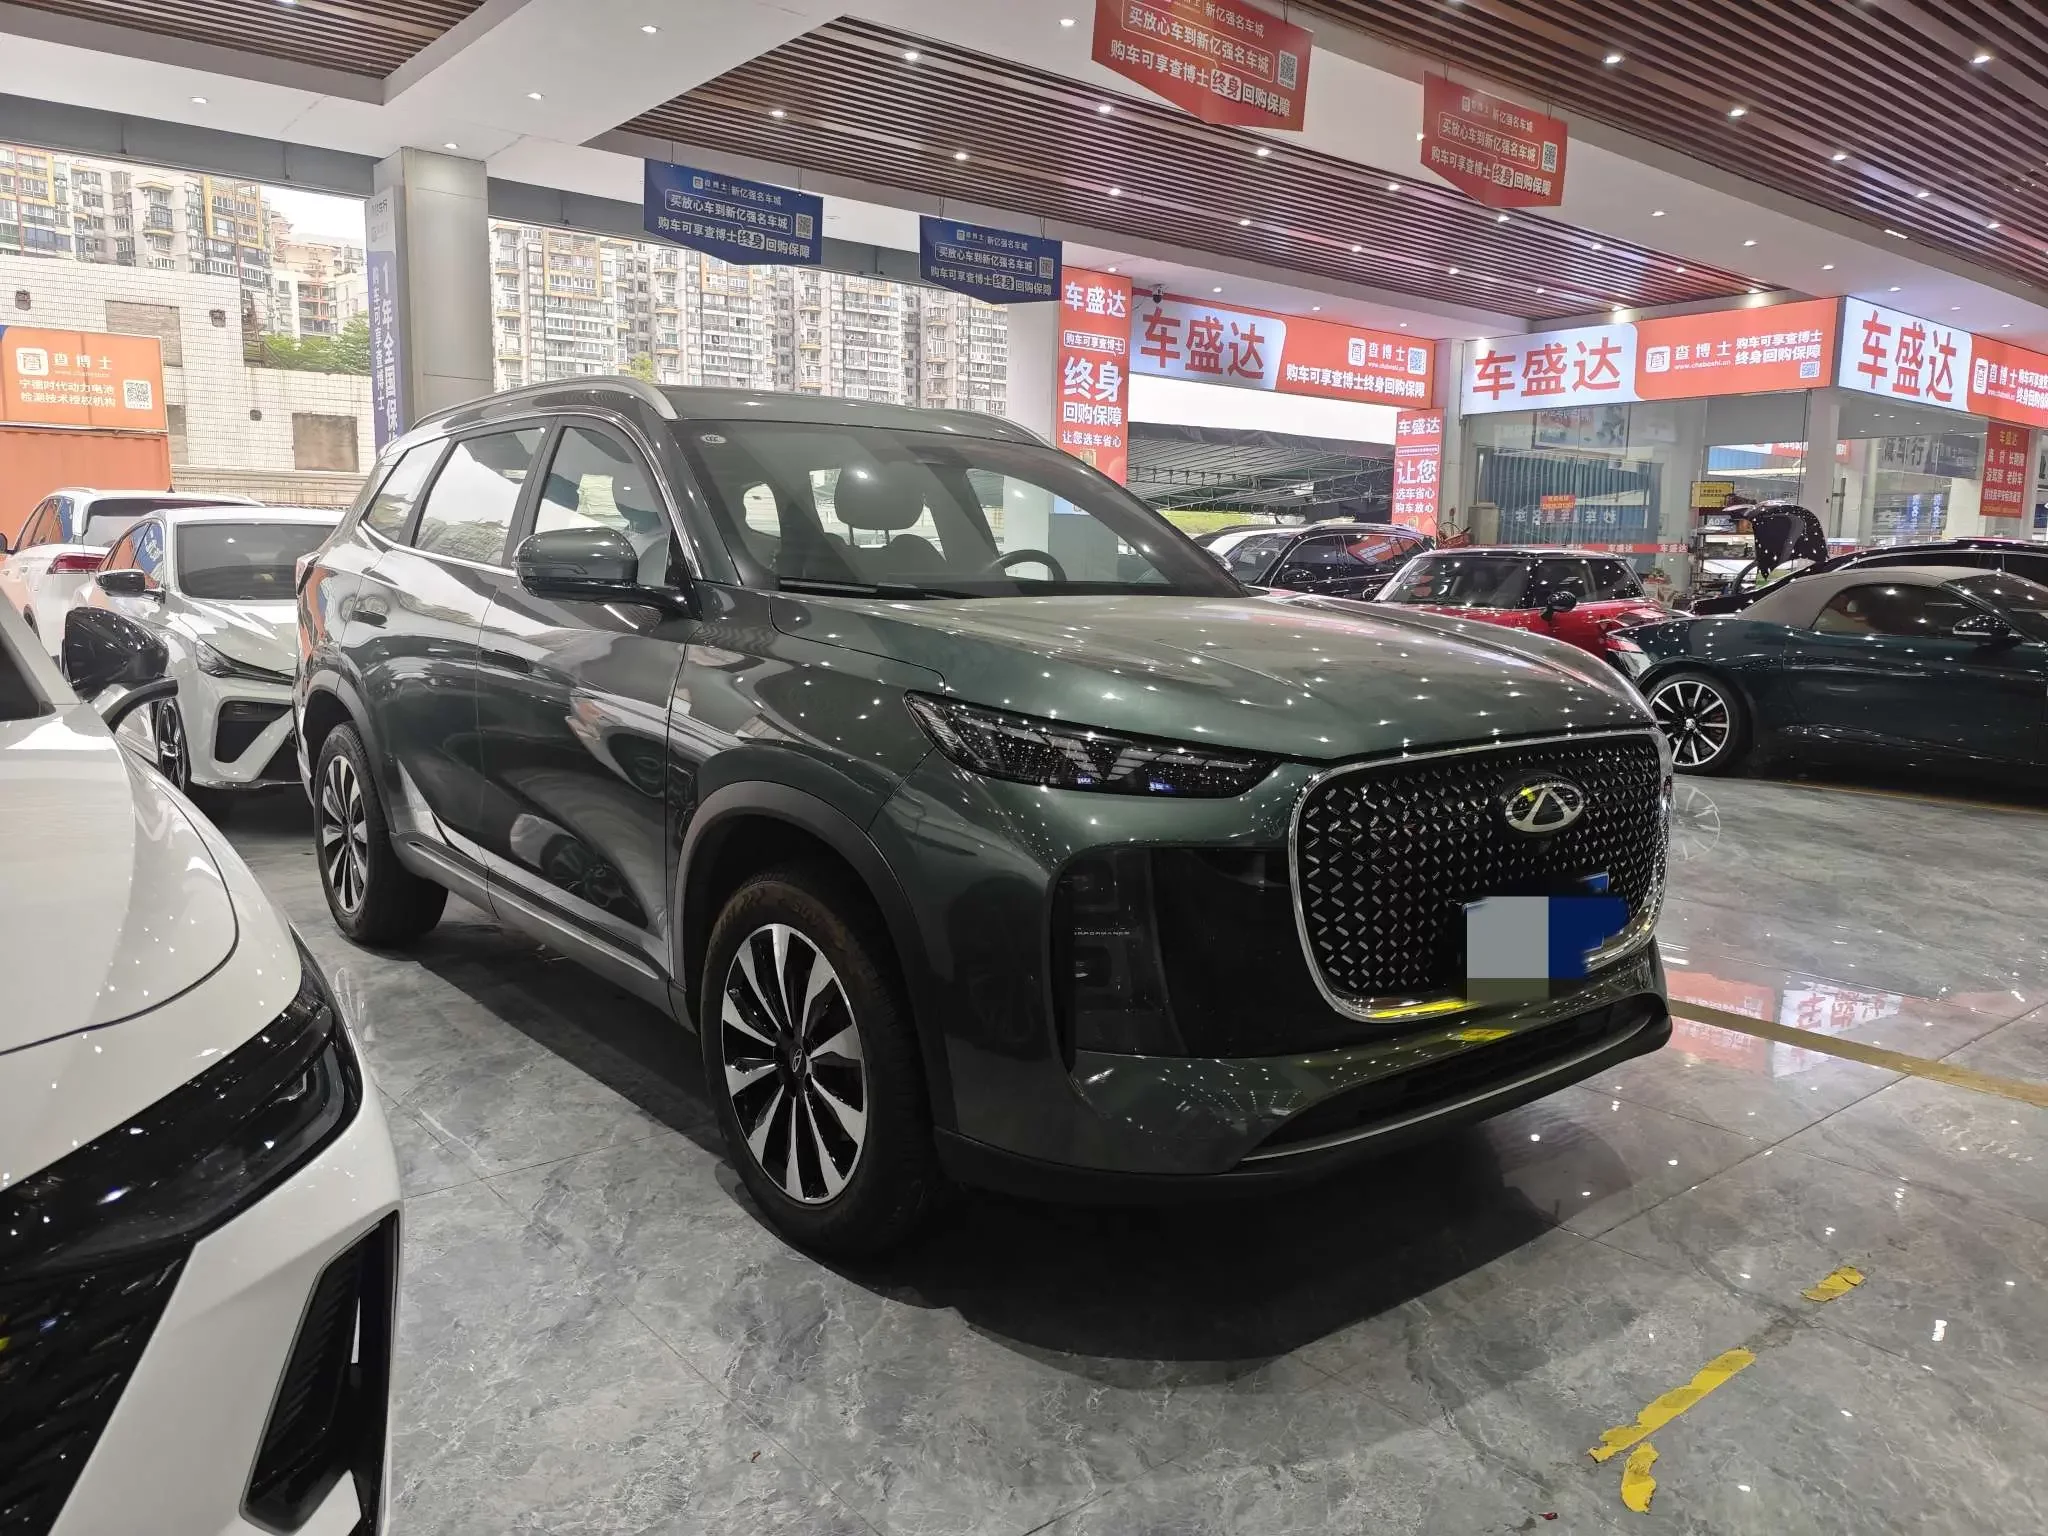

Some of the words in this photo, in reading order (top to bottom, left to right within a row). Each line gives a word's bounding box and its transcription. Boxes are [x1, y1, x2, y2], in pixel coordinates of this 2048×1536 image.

[1205, 4, 1265, 39] 新亿强名车城
[1128, 6, 1270, 75] 买放心车到新亿强名车城
[1110, 40, 1291, 117] 购车可享查博士终身回购保障
[1442, 119, 1536, 162] 买放心车到新亿强名车城
[731, 185, 782, 206] 新亿强名车城
[670, 194, 788, 230] 买放心车到新亿强名车城
[657, 216, 811, 259] 购车可享查博士终身回购保障
[939, 246, 1033, 272] 买放心车到新亿强名车城
[1064, 281, 1126, 318] 车盛达
[1066, 332, 1124, 353] 购车可享查博士
[1140, 306, 1265, 379] 车盛达
[1368, 342, 1406, 362] 查博士
[1674, 340, 1732, 361] 查博士
[1735, 329, 1823, 350] 购车可享查博士
[1734, 344, 1821, 366] 终身回购保障
[1857, 310, 1957, 402] 车盛达
[1063, 356, 1122, 403] 终身
[1286, 363, 1425, 398] 购车可享查博士终身回购保障
[1473, 337, 1622, 400] 车盛达
[19, 379, 115, 394] 宁德时代动力电池
[20, 391, 117, 408] 检测技术授权机构
[1063, 401, 1122, 428] 回购保障
[1397, 417, 1440, 436] 车盛达
[1062, 430, 1122, 448] 让您选车省心
[1396, 459, 1437, 484] 让您
[1395, 488, 1436, 499] 选车省心
